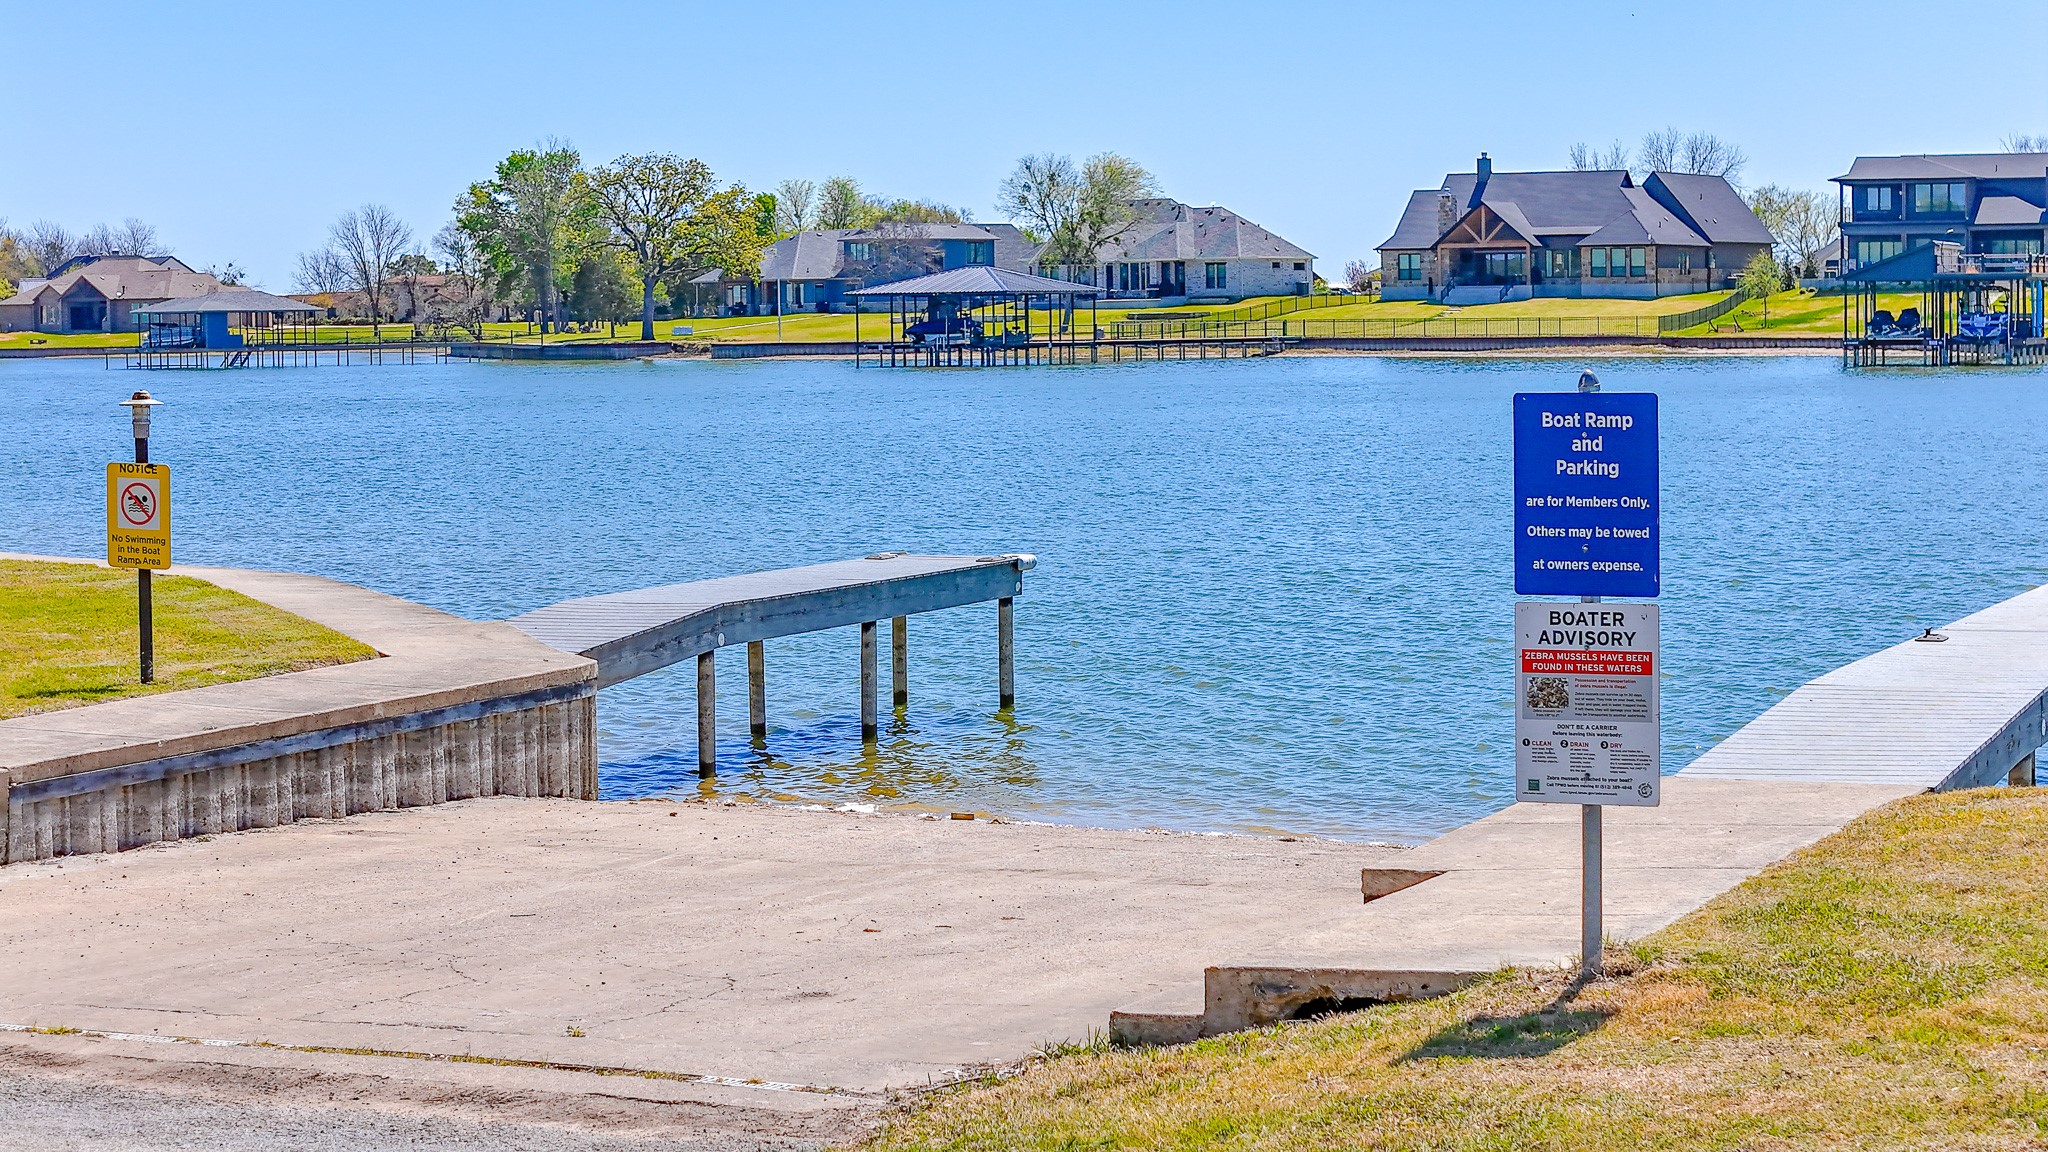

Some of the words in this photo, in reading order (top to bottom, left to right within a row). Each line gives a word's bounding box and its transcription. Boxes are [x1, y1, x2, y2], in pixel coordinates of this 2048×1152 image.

[1541, 412, 1580, 428] Boat
[1584, 412, 1633, 430] Ramp
[1572, 436, 1603, 452] and
[120, 464, 158, 474] NOTICE
[1556, 460, 1619, 478] Parking
[1526, 497, 1544, 506] are
[1546, 496, 1563, 506] for
[1566, 496, 1618, 508] Members
[1620, 496, 1650, 510] Only.
[1527, 526, 1566, 537] Others
[1568, 528, 1592, 540] may
[1595, 526, 1610, 538] be
[1613, 527, 1649, 538] towed
[125, 535, 166, 546] Swimming
[142, 546, 160, 555] Boat
[117, 556, 141, 565] Ramp
[142, 557, 160, 565] Area
[1532, 559, 1544, 569] at
[1547, 561, 1589, 570] owners
[1591, 562, 1643, 572] expense.
[1550, 611, 1625, 626] BOATER
[1538, 630, 1636, 646] ADVISORY
[1525, 652, 1554, 660] ZEBRA
[1557, 652, 1597, 661] MUSSELS
[1532, 662, 1562, 671] FOUND
[1576, 664, 1604, 672] THESE
[1607, 664, 1642, 672] WATERS
